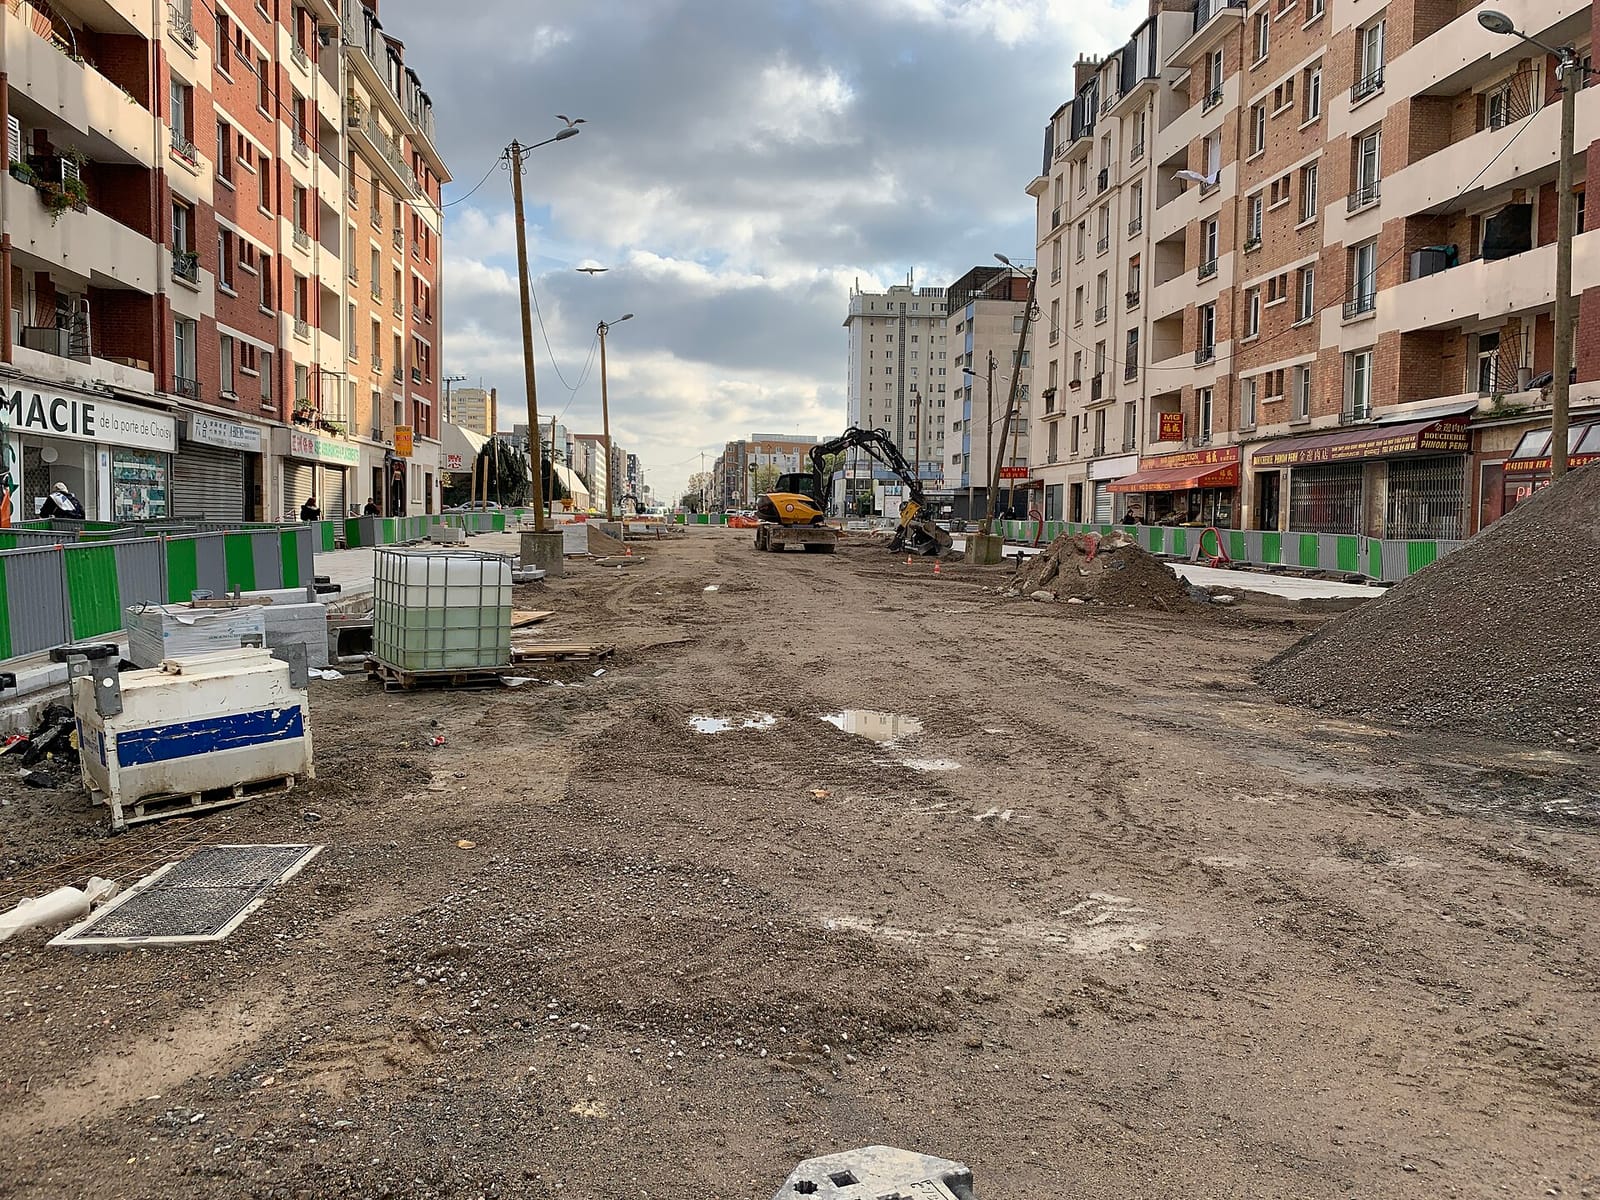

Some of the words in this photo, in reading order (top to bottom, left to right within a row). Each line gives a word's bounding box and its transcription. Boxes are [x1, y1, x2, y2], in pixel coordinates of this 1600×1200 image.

[99, 412, 110, 429] de
[111, 413, 119, 430] la
[120, 417, 139, 435] porte
[140, 419, 149, 436] de
[150, 421, 172, 442] Choisy
[1424, 432, 1466, 441] BOUCHERIE
[1420, 440, 1447, 449] PHNOM
[1448, 441, 1469, 450] PENH
